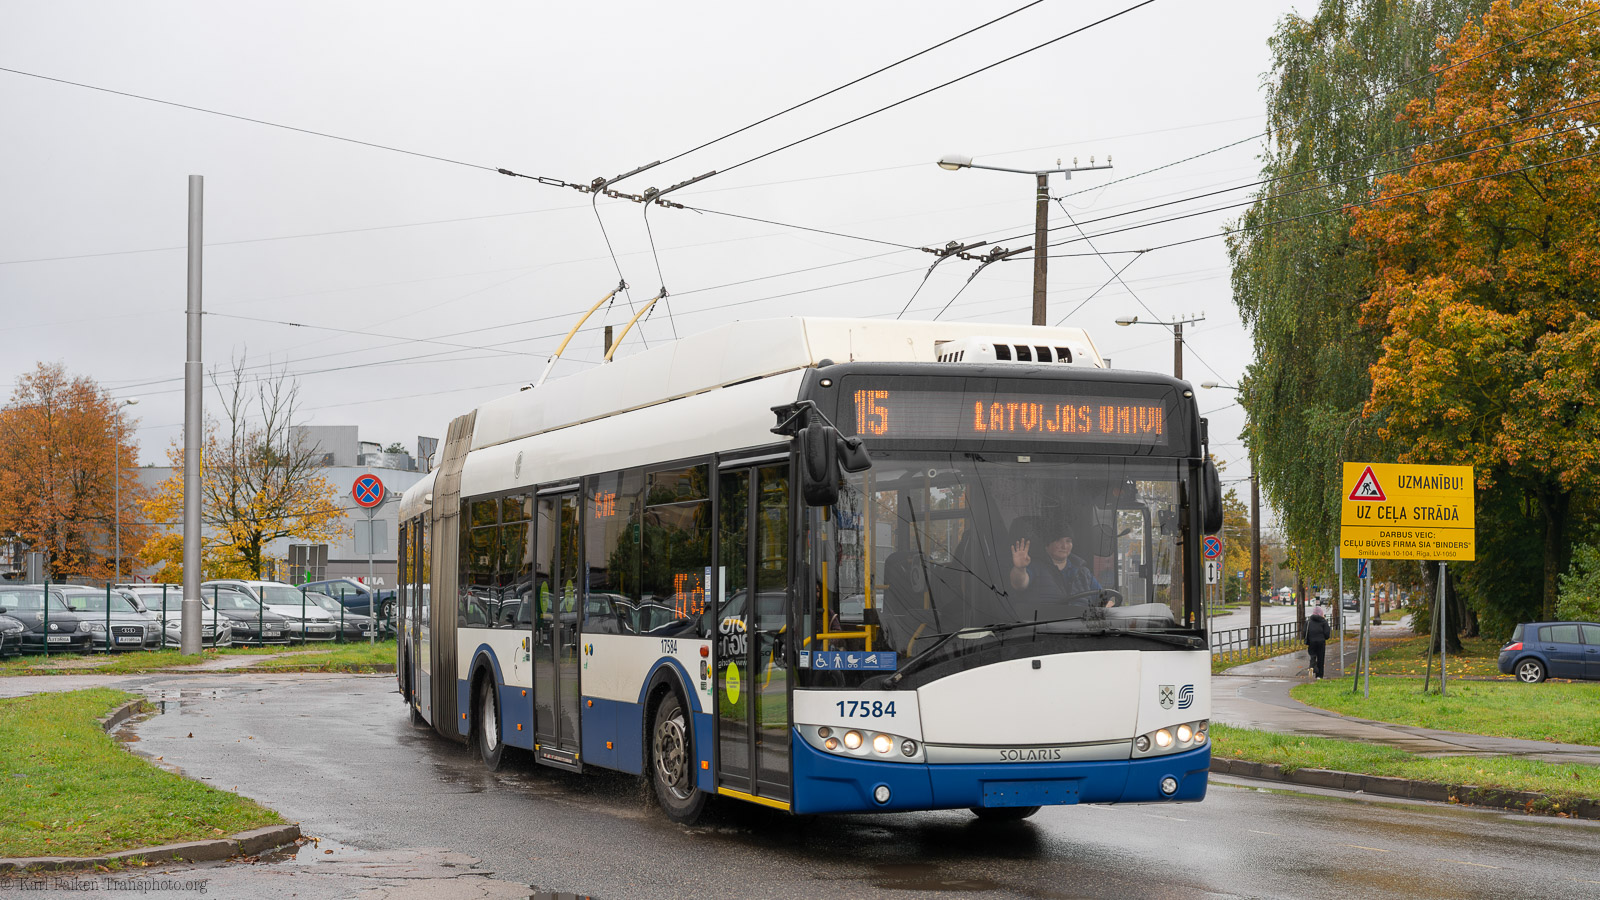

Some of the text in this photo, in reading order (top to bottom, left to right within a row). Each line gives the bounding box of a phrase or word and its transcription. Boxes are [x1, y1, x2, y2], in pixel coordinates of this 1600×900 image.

[854, 389, 889, 435] 15
[974, 400, 1092, 433] LATVIJAS
[1398, 474, 1464, 490] UZMANĪBU!
[1357, 505, 1459, 523] UZ CEĻA STRĀDĀ
[1415, 531, 1436, 539] VEIC:
[1343, 540, 1364, 548] CEĻU
[1366, 539, 1391, 548] BŪVES
[1393, 540, 1416, 548] FIRMA
[1393, 550, 1415, 558] 10-104,
[661, 639, 678, 654] 17584
[835, 700, 897, 718] 17584
[999, 748, 1062, 761] SOLARIS
